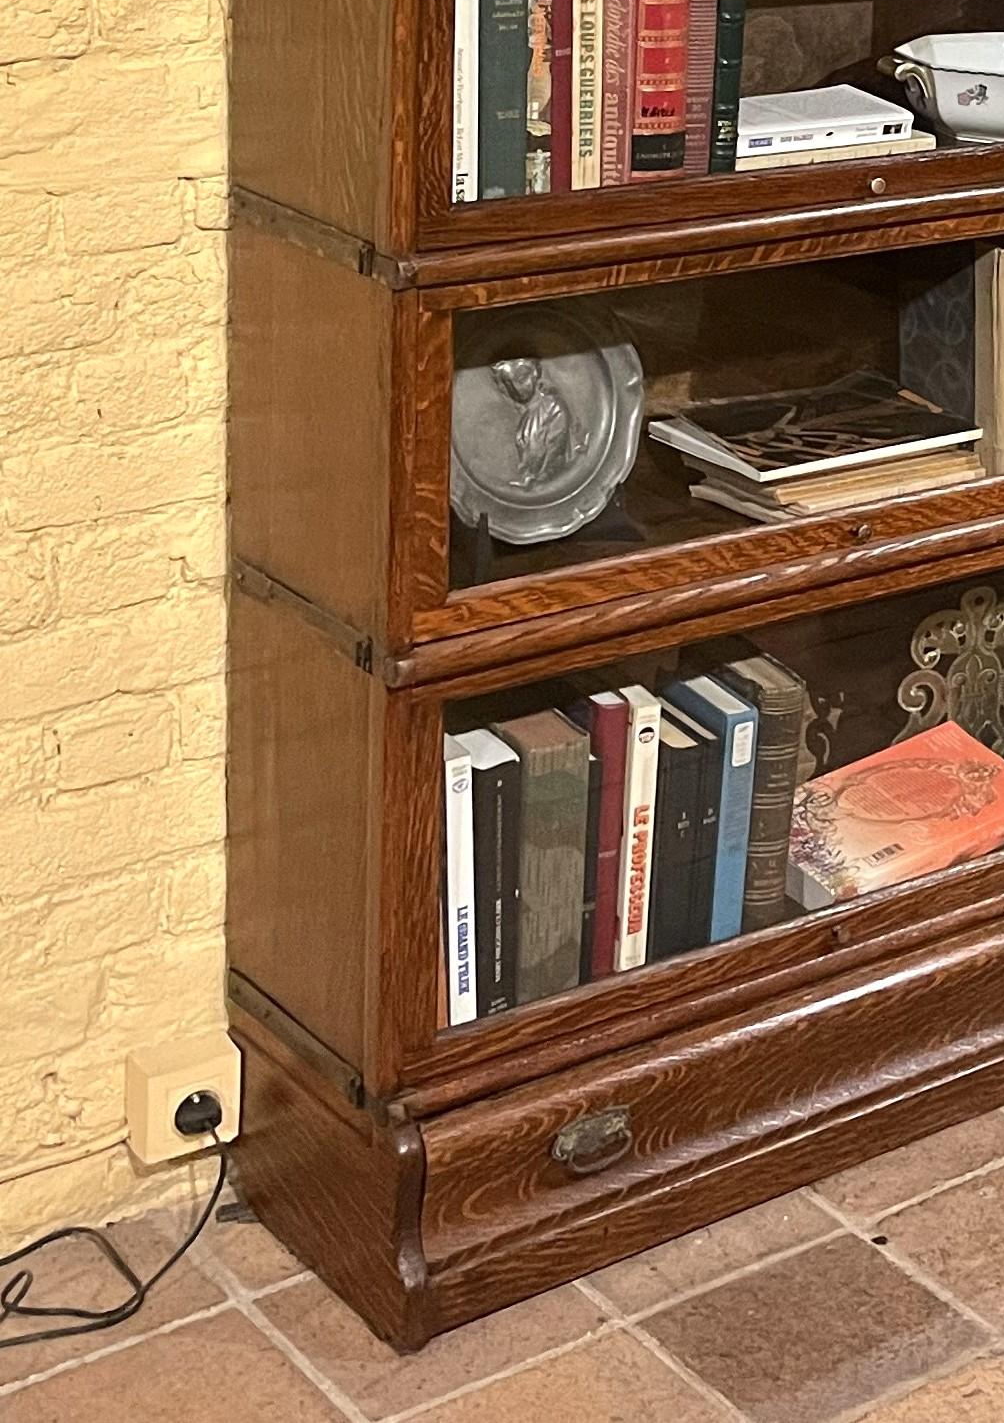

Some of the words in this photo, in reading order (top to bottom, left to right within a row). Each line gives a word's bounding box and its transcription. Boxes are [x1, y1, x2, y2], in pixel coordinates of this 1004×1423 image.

[579, 11, 595, 66] LOUPS
[605, 59, 624, 86] des
[577, 67, 595, 158] GUERRIERS
[456, 173, 469, 186] la
[634, 804, 650, 826] LE
[627, 830, 649, 936] PROFESSEUR
[456, 905, 469, 922] LE
[457, 923, 469, 961] GRAND
[458, 962, 470, 996] TREK
